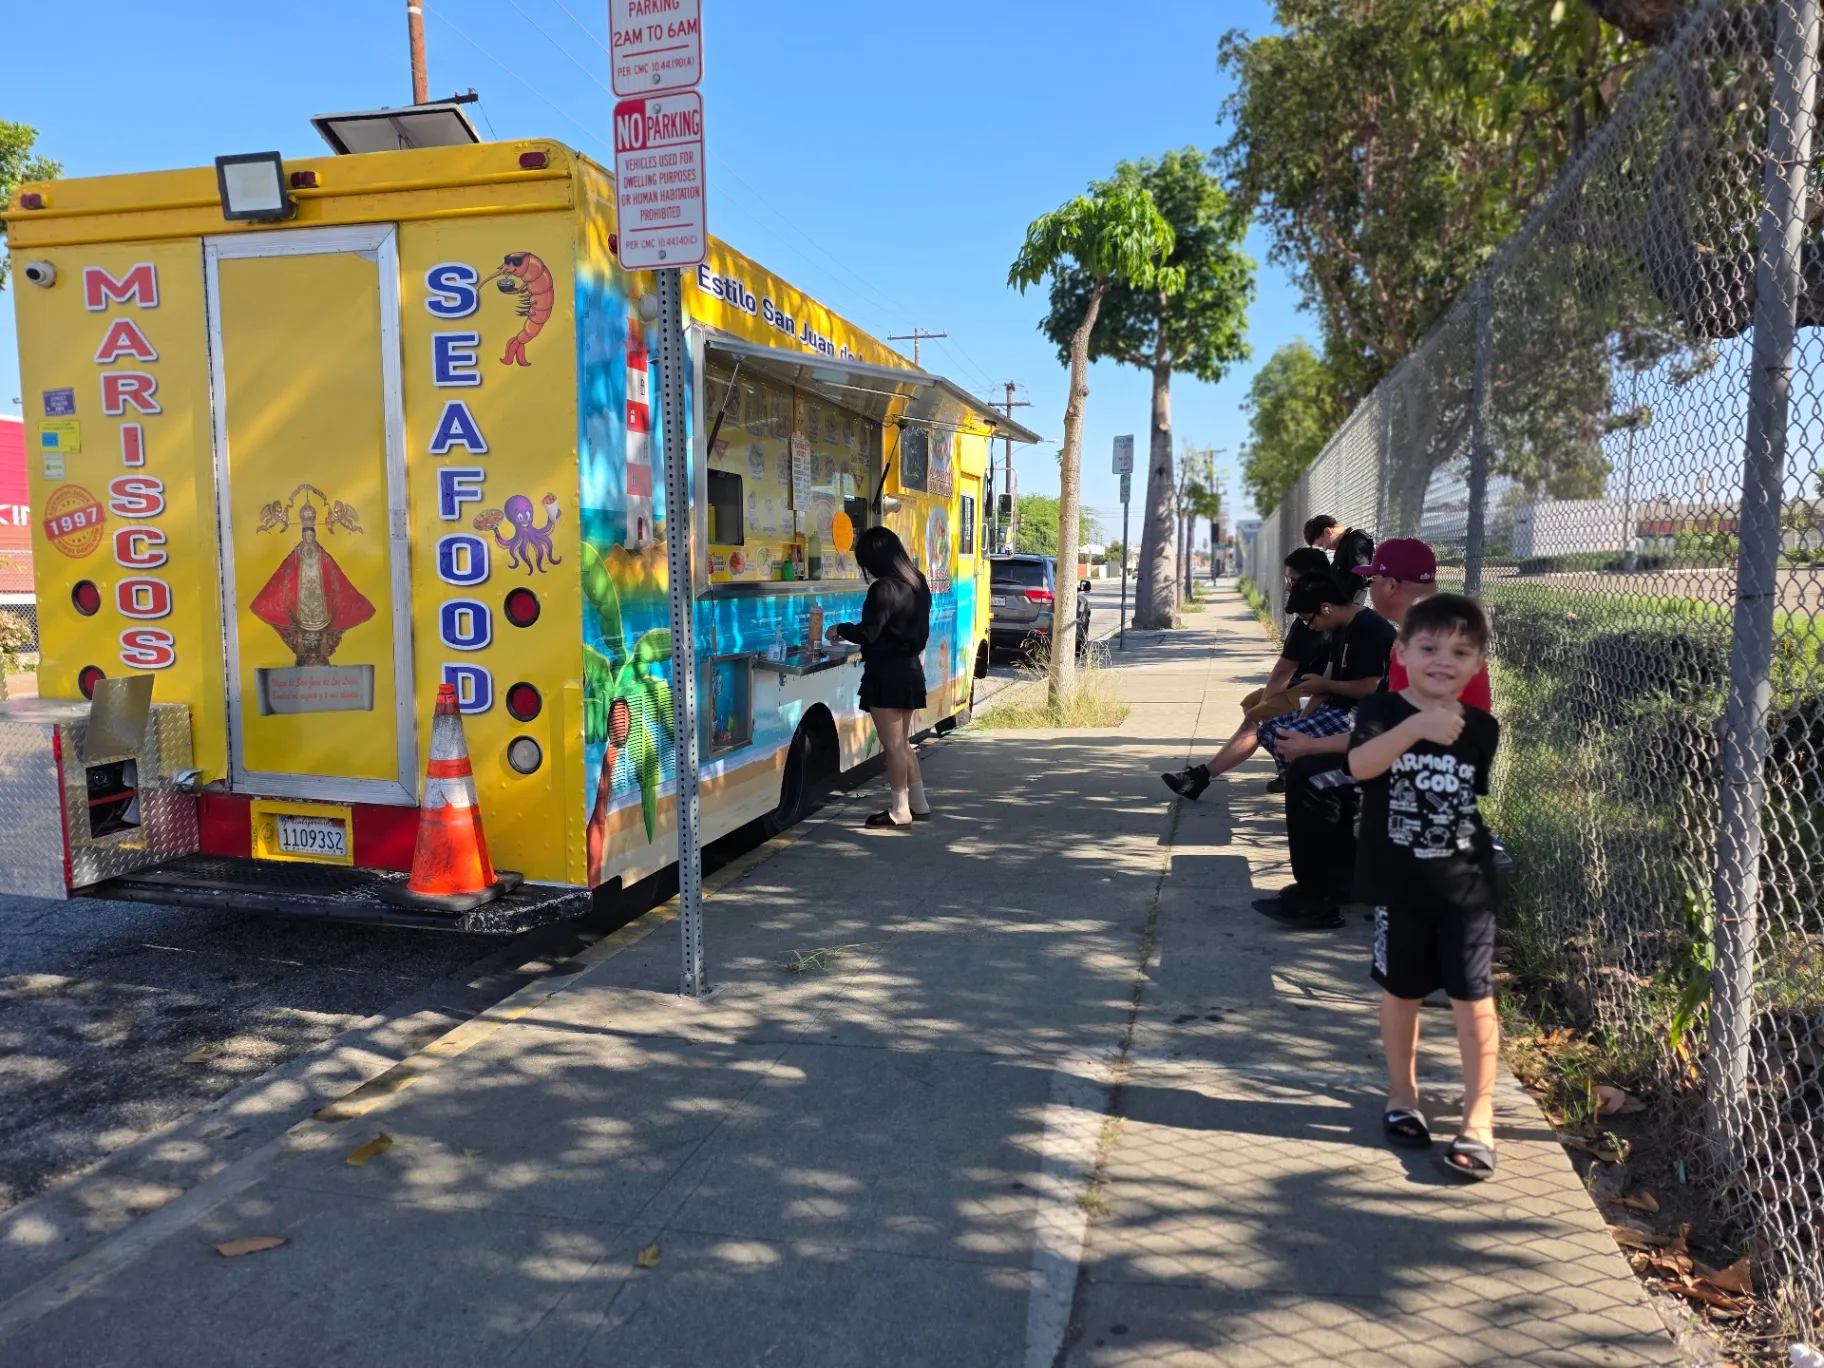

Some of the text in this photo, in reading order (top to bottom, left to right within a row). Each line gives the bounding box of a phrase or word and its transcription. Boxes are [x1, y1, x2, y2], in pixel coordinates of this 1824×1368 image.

[629, 0, 680, 18] PARKING
[613, 17, 698, 48] 2AM TO 6AM
[617, 66, 631, 77] PER
[634, 63, 649, 75] CMC
[616, 109, 700, 150] NO PARKING
[625, 151, 694, 171] VEHICLES USED FOR
[623, 168, 696, 189] DWELLING PURPOSES
[621, 185, 700, 206] OR HUMAN HABITATION
[640, 205, 681, 221] PROHIBITED
[625, 240, 639, 250] PER
[641, 239, 655, 249] CMC
[697, 262, 757, 313] Estilo
[762, 297, 796, 336] San
[799, 322, 836, 357] Juan
[83, 262, 175, 670] MARISCOS
[424, 262, 494, 714] SEAFOOD
[50, 506, 97, 535] 1997
[1391, 752, 1476, 780] ARMOR OF
[1415, 770, 1460, 793] GOD
[283, 827, 345, 851] 11093S2
